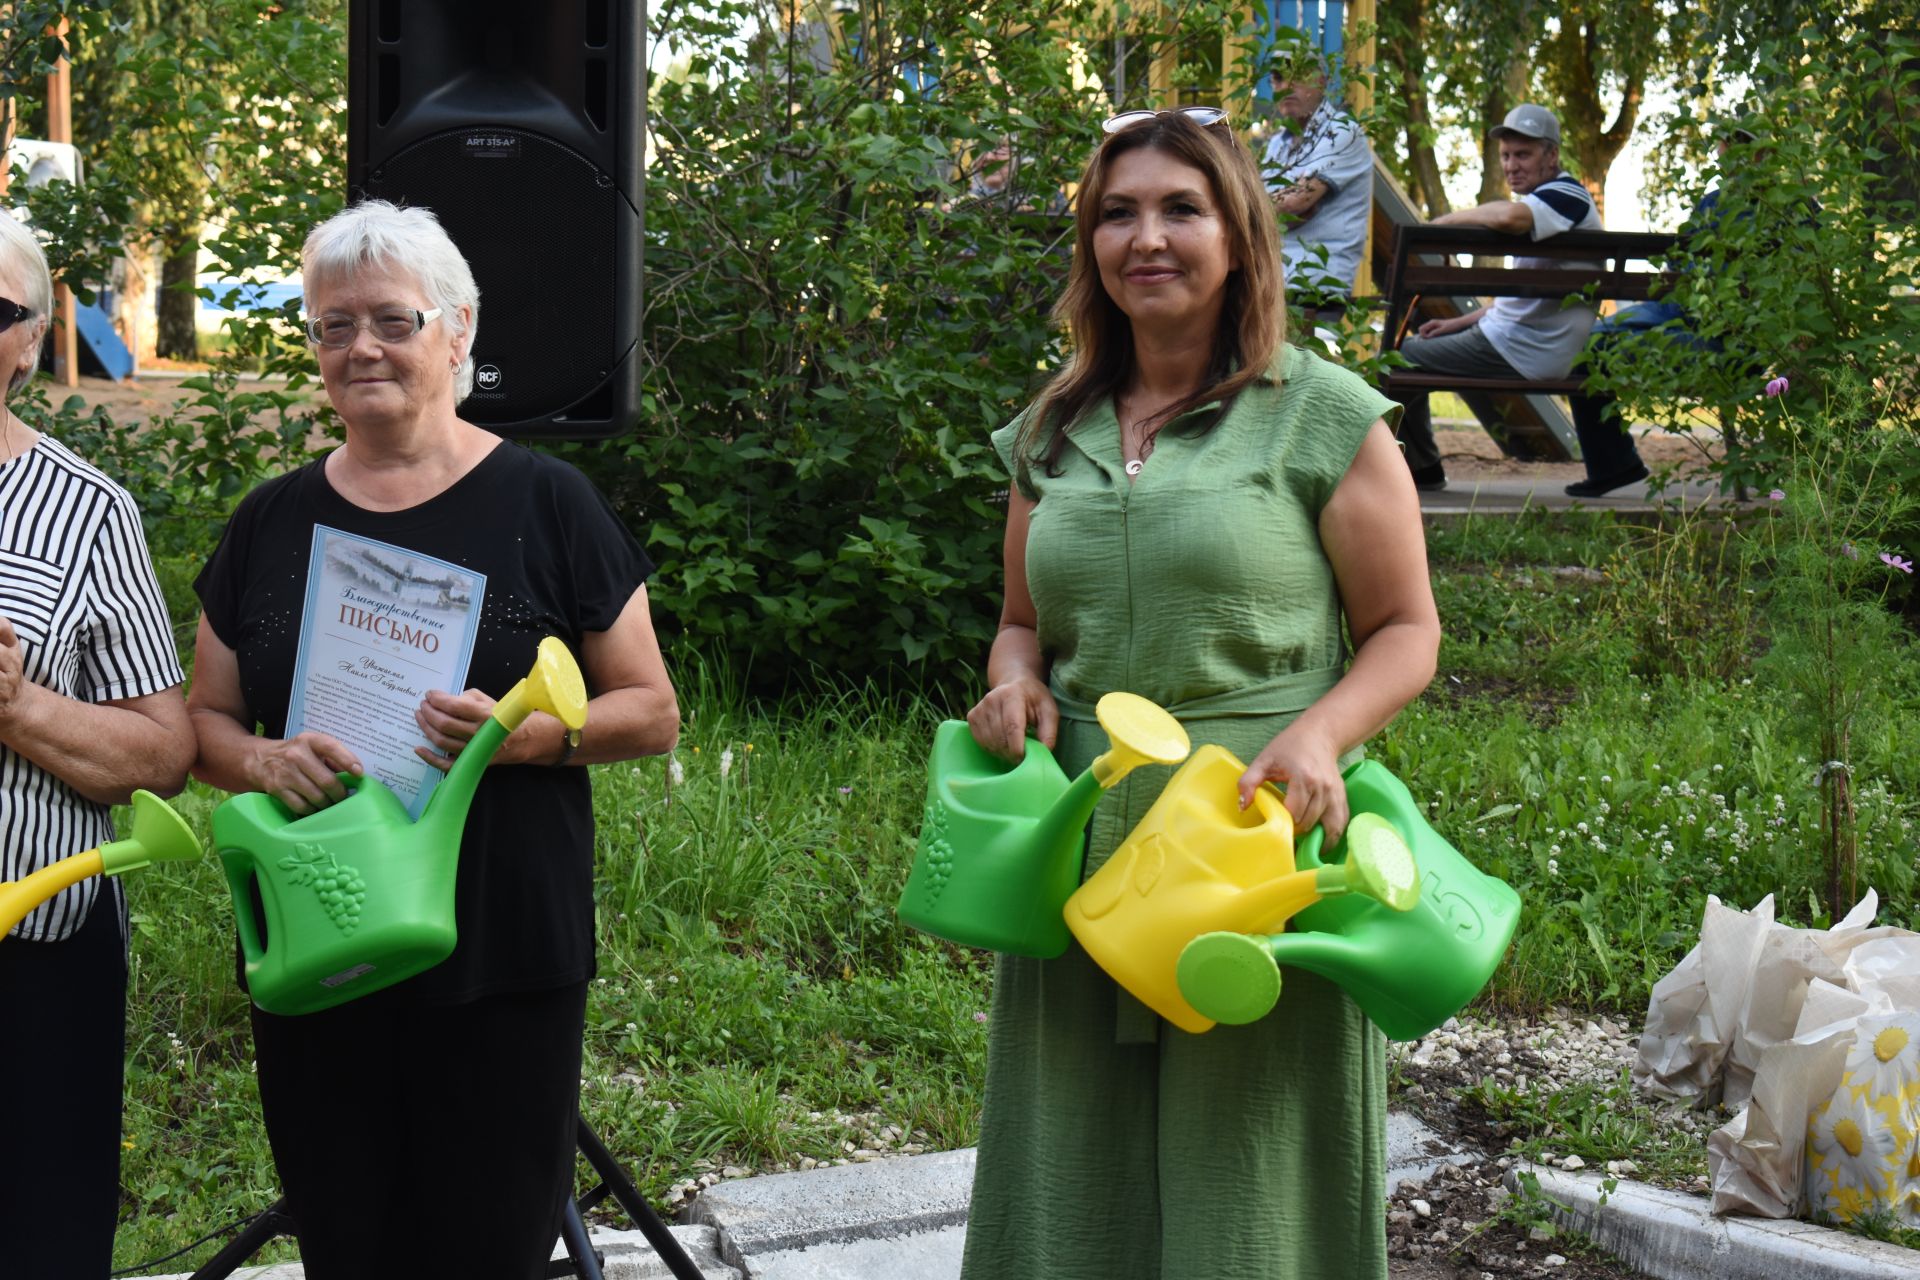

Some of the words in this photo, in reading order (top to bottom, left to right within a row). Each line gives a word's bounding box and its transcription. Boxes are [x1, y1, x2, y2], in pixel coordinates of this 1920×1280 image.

[466, 138, 486, 146] ART
[478, 371, 499, 382] RCF
[340, 585, 446, 630] Благодарственное
[337, 603, 440, 653] ПИСЬМО
[359, 656, 405, 680] Уважаемая
